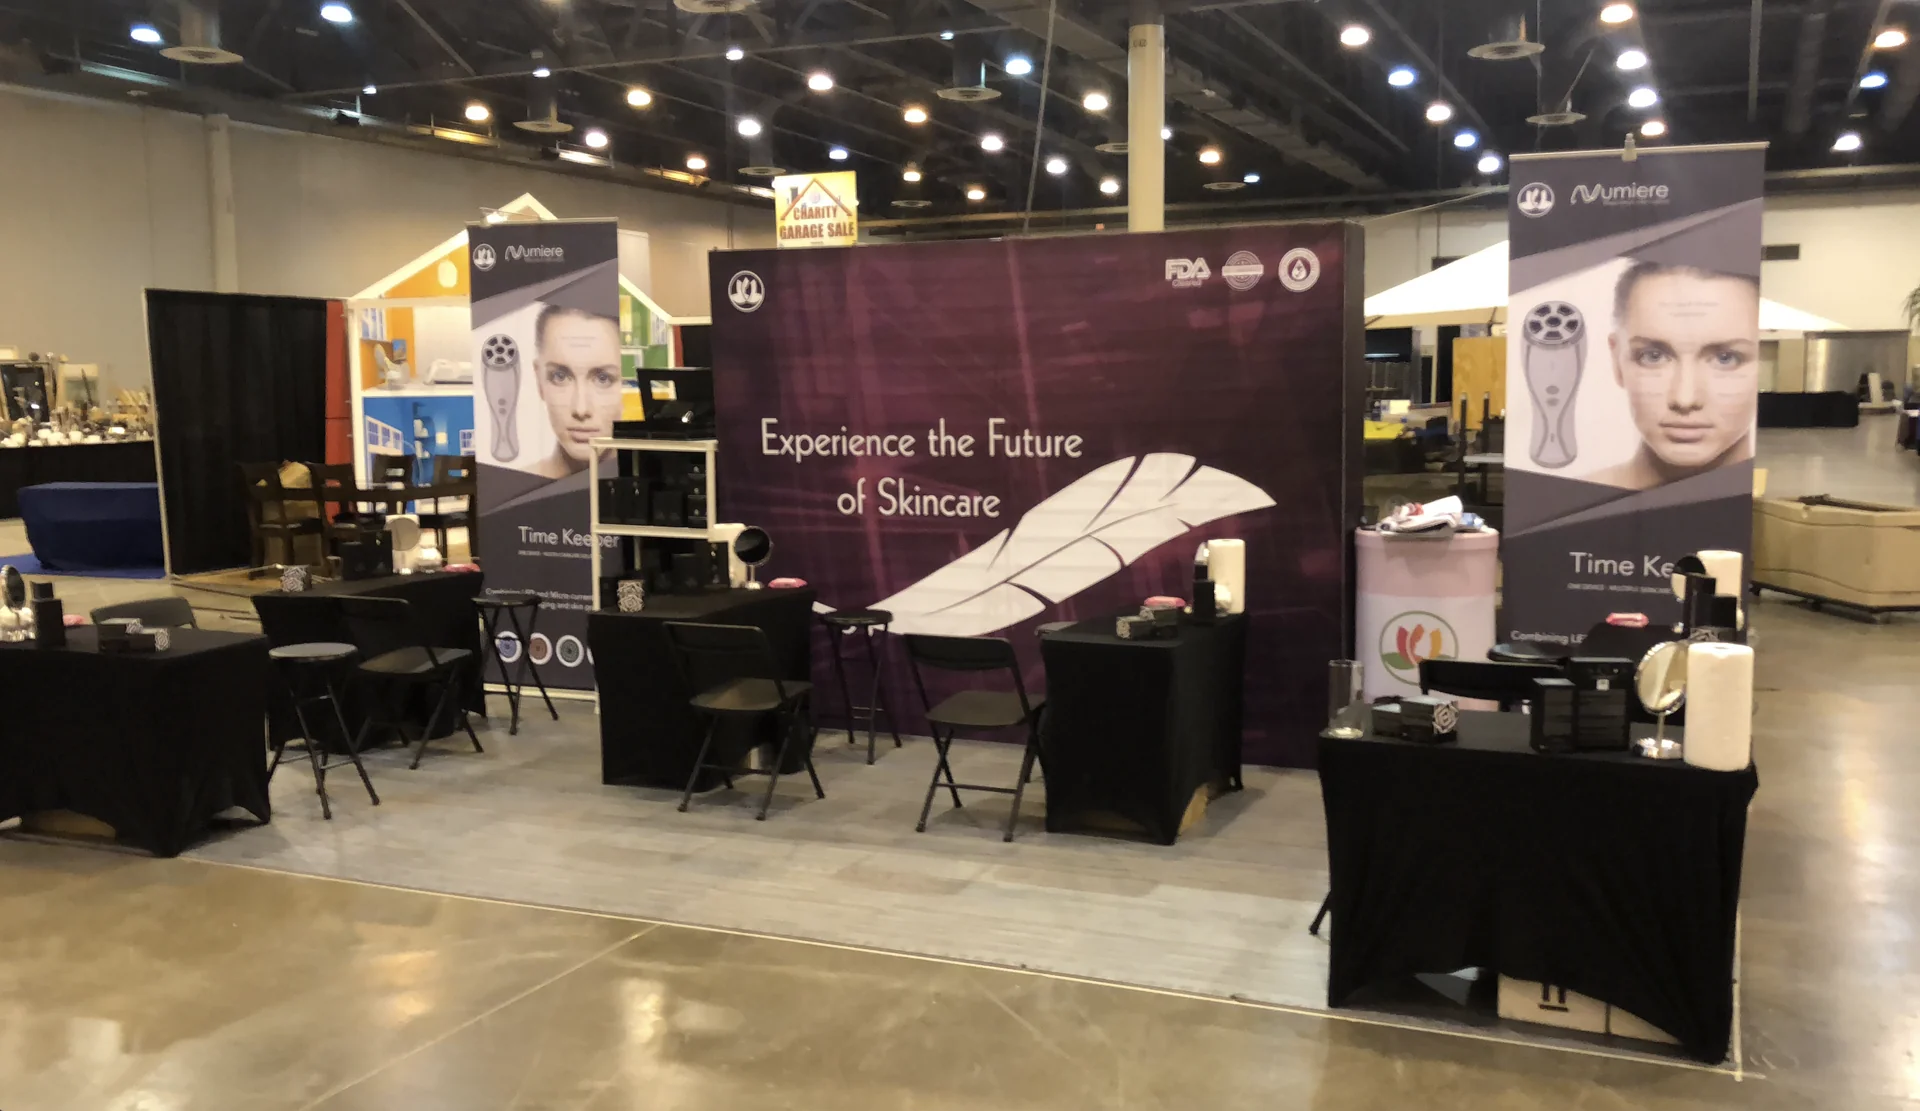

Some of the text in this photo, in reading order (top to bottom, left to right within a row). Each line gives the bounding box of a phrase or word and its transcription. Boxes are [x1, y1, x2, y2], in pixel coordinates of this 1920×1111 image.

[793, 205, 837, 220] CHARITY
[780, 222, 854, 240] GARAGE SALE
[1165, 257, 1211, 280] FDA
[761, 417, 1083, 463] Experience the Future
[837, 477, 1000, 517] of Skincare
[518, 526, 558, 545] Time
[1569, 551, 1635, 576] Time
[1510, 630, 1569, 645] Combining
